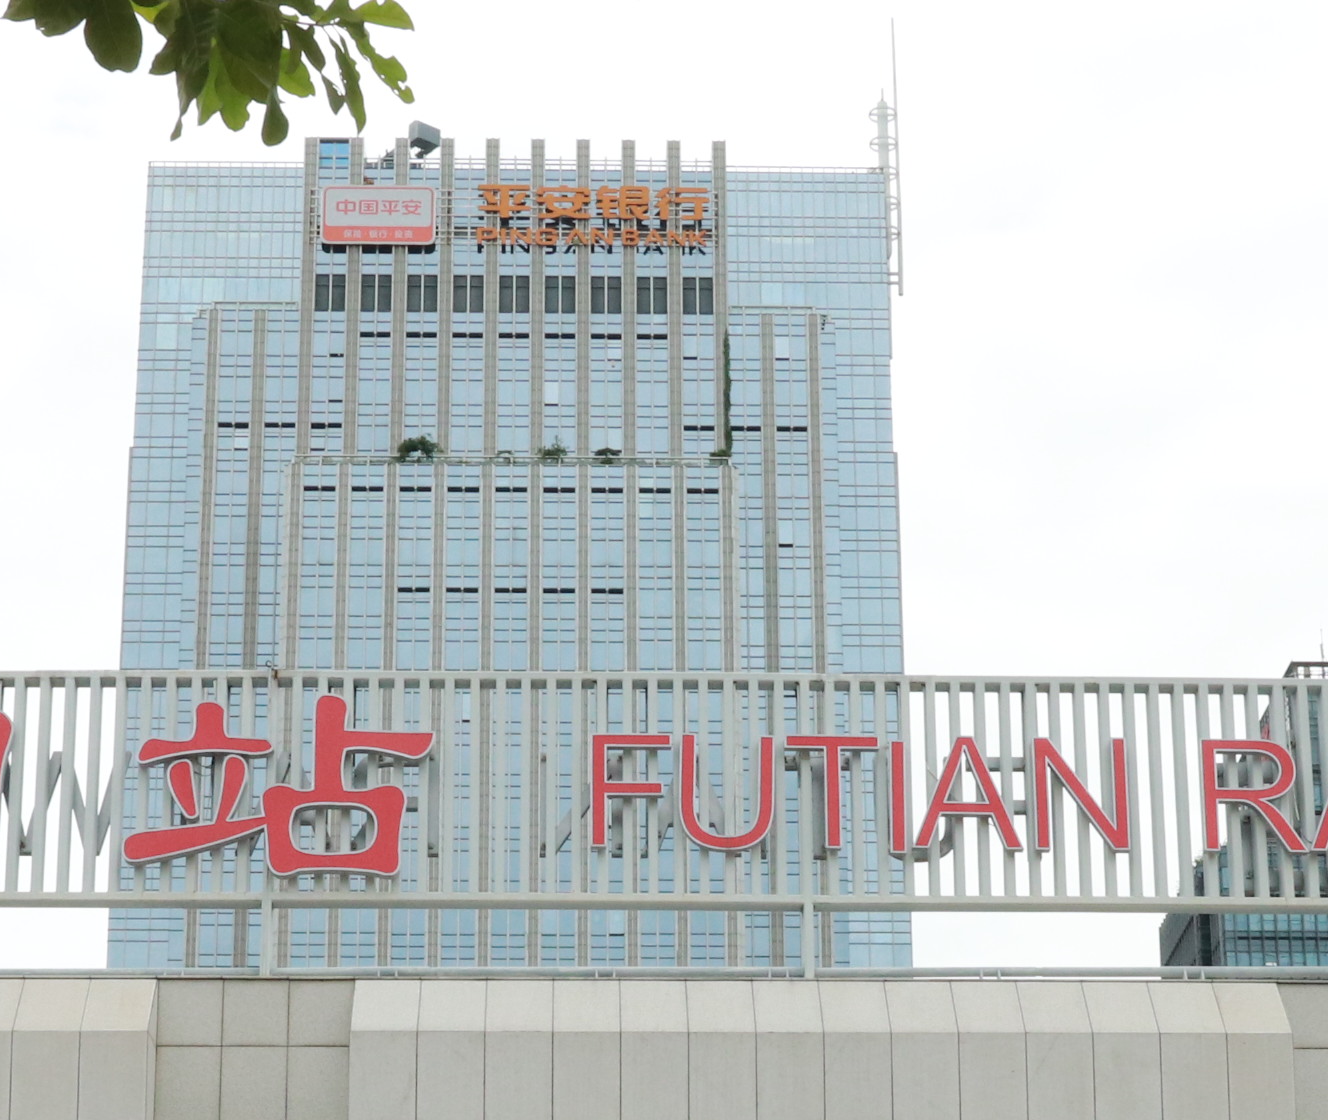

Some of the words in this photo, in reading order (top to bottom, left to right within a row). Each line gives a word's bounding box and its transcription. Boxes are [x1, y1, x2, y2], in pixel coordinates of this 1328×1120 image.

[336, 199, 422, 216] 中国平安
[477, 184, 710, 221] 平安银行
[475, 227, 559, 246] PING
[621, 229, 707, 247] BANK
[590, 733, 1132, 855] FUTIAN
